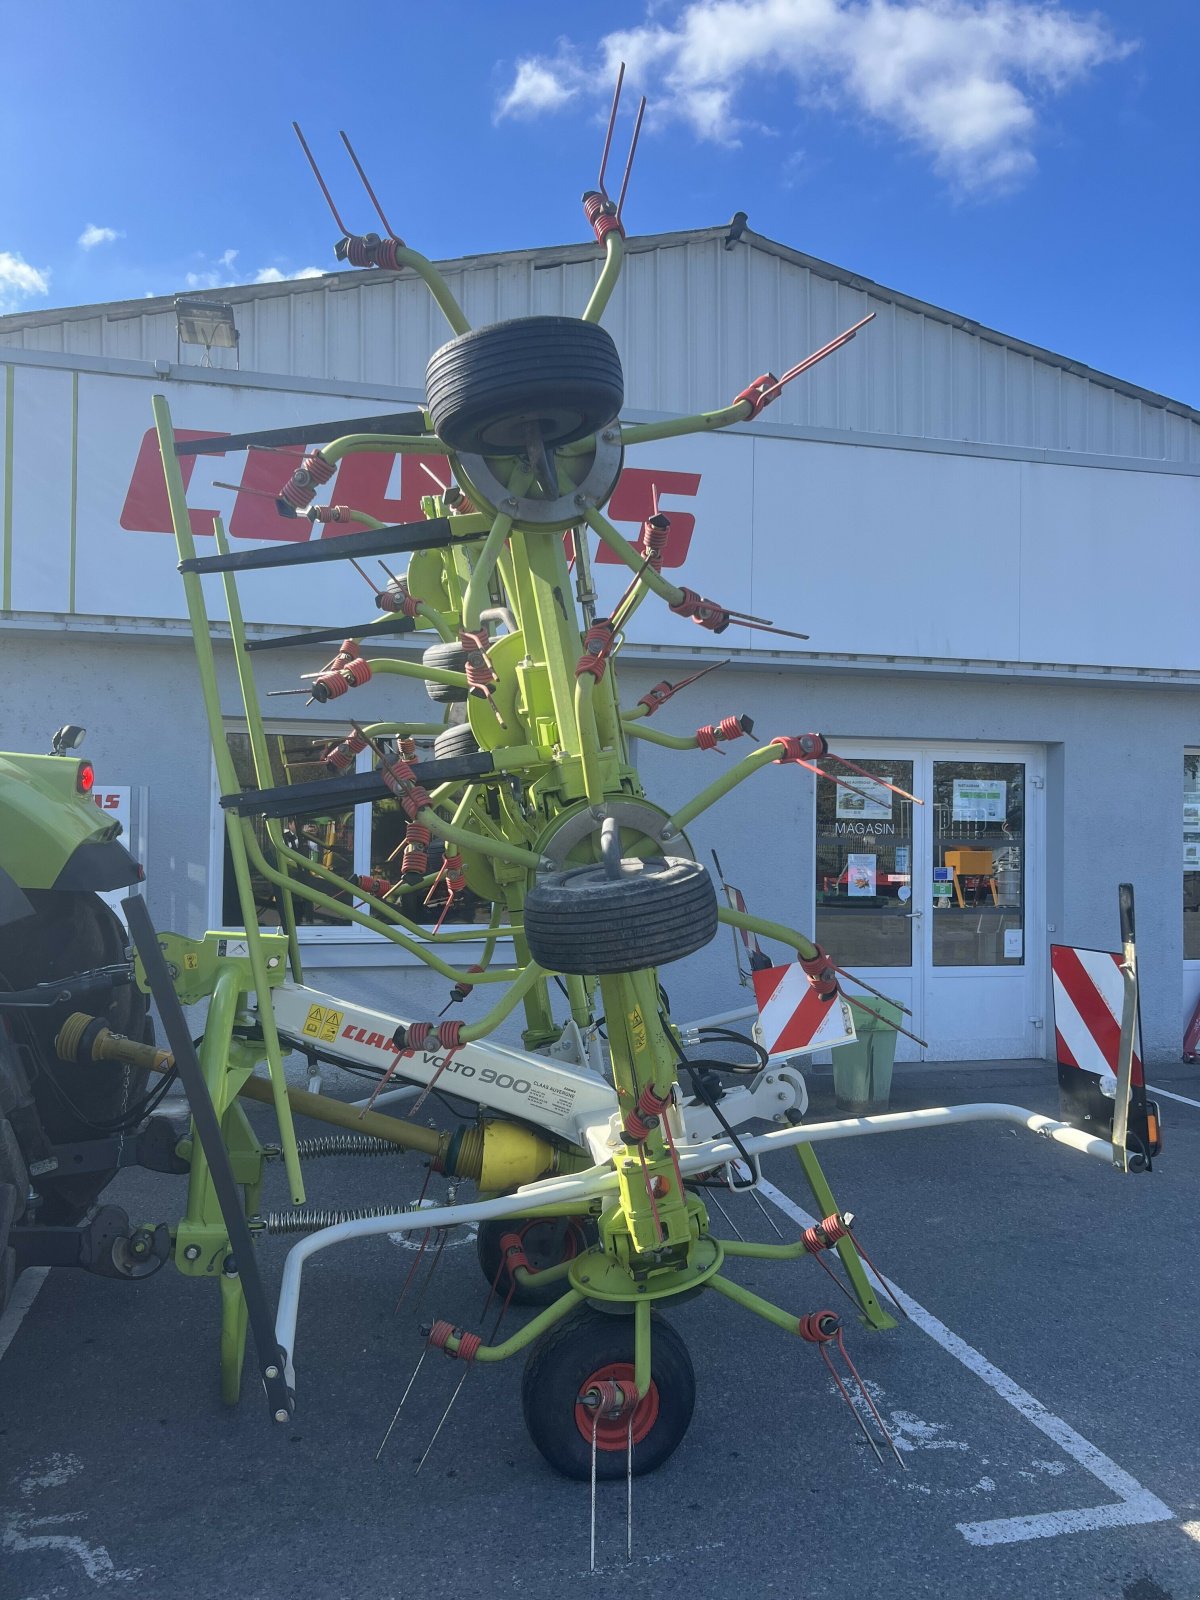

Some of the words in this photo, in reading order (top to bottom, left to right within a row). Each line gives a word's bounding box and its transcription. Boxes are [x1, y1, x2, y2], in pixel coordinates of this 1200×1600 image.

[835, 822, 895, 835] MAGASIN
[423, 1052, 476, 1077] VOLTO
[478, 1068, 531, 1094] 900
[533, 1080, 549, 1090] CLAAS
[549, 1086, 576, 1099] AUVERGNE
